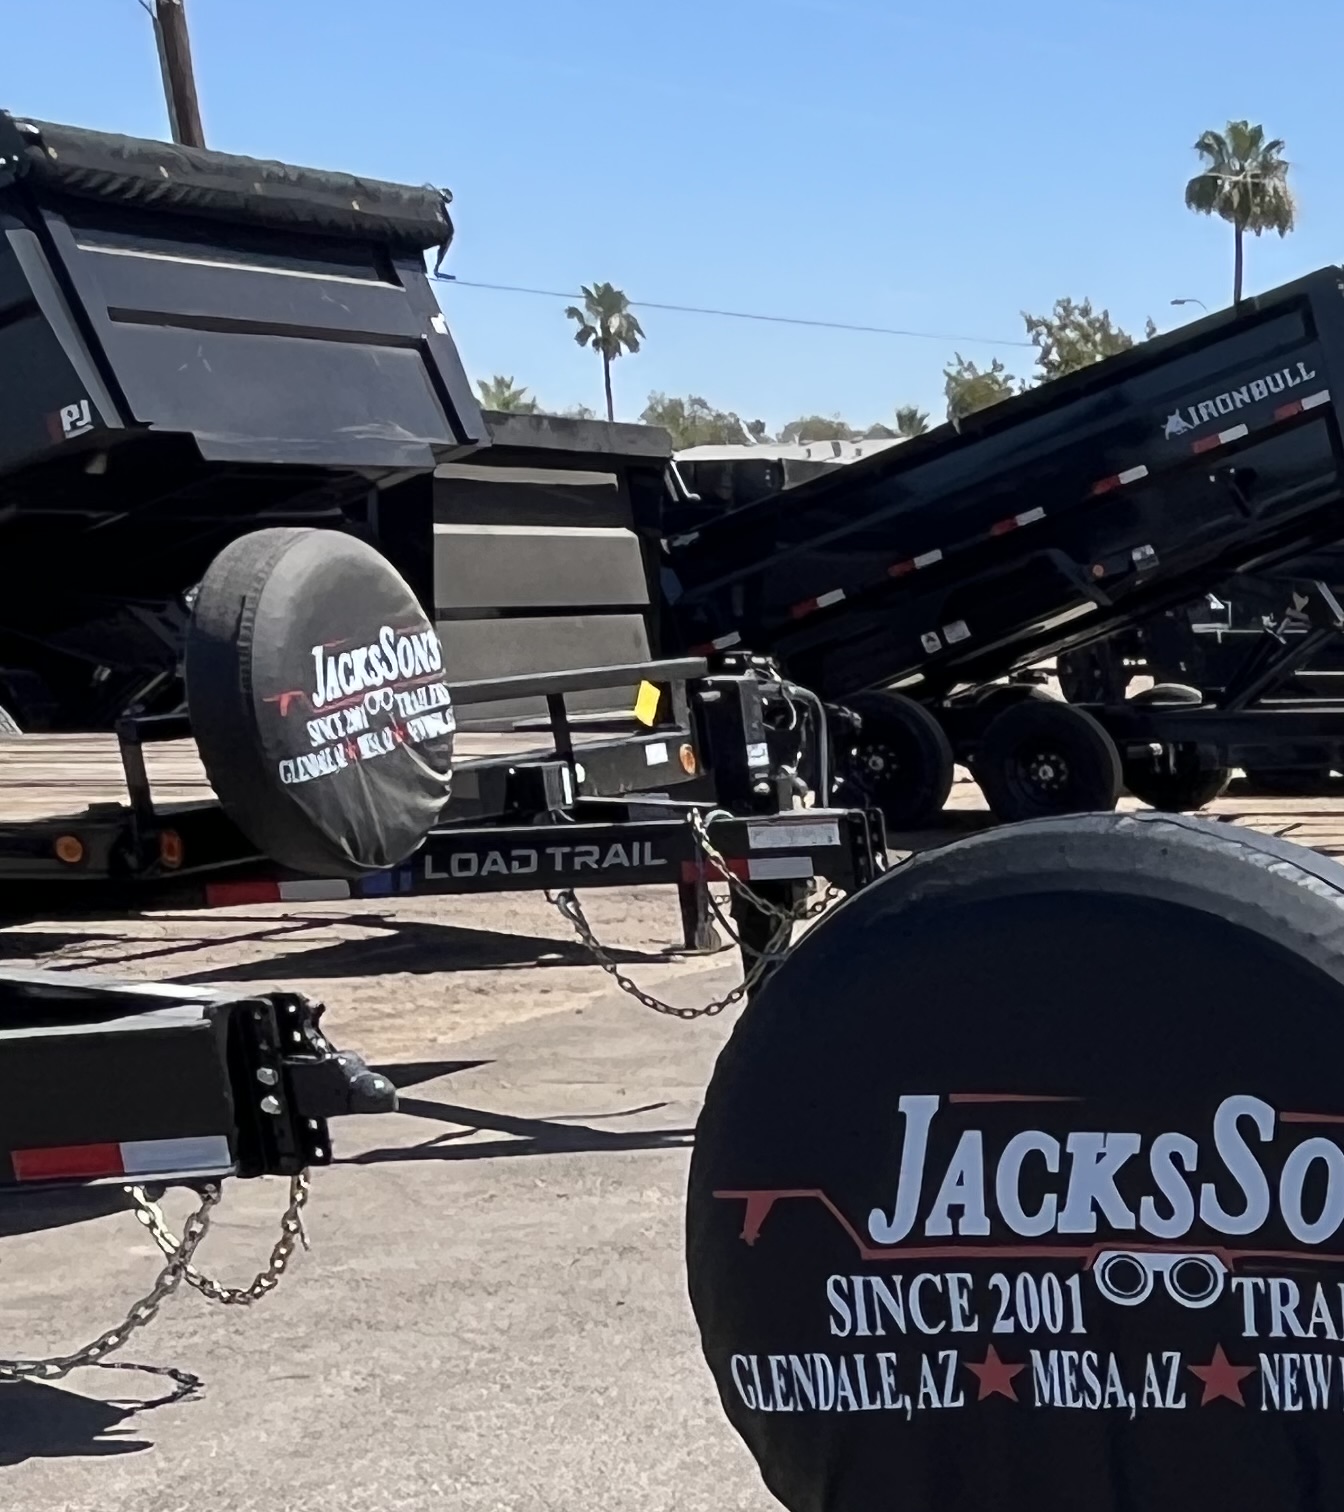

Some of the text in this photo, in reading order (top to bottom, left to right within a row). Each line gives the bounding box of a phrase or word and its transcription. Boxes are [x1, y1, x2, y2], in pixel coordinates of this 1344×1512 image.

[60, 399, 92, 432] PJ
[1187, 361, 1317, 427] IRONBULL
[423, 841, 668, 880] LOAD TRAIL
[826, 1271, 1088, 1338] SINCE 2001
[730, 1349, 965, 1422] GLENDALE, AZ
[1029, 1349, 1187, 1421] MESA, AZ
[1259, 1352, 1333, 1413] NEW
